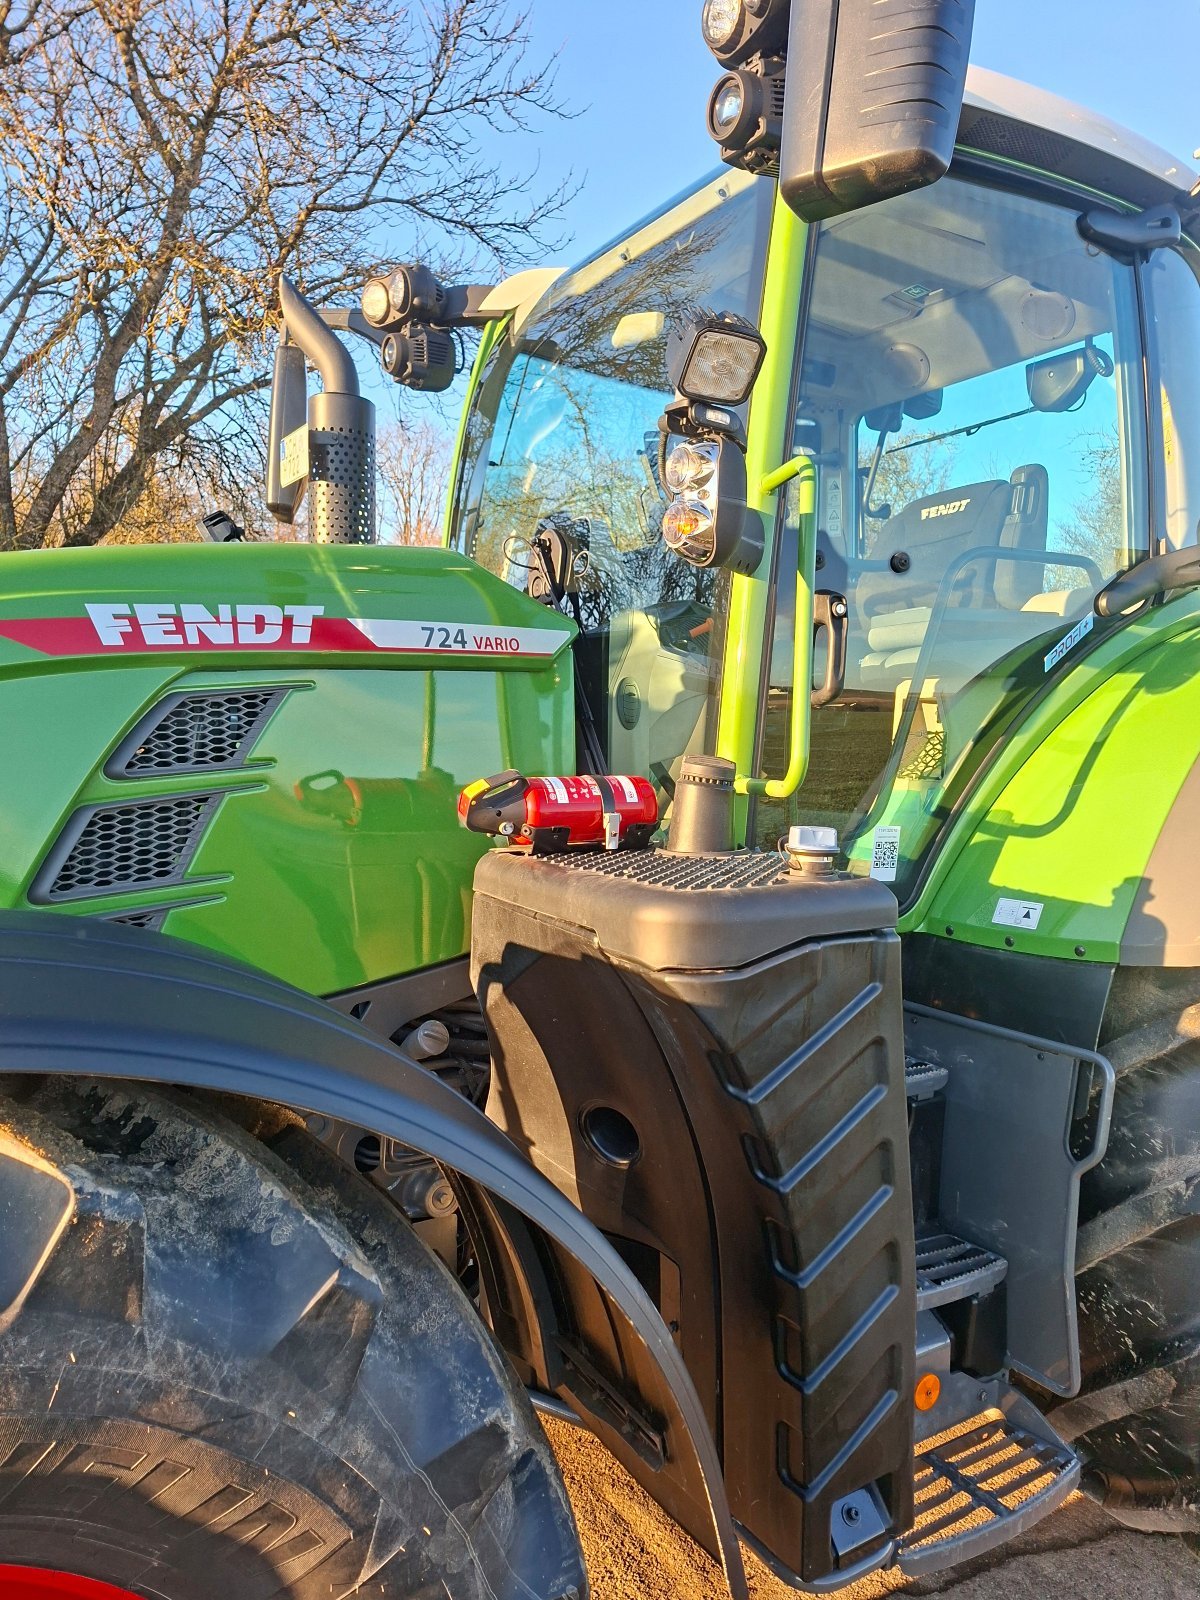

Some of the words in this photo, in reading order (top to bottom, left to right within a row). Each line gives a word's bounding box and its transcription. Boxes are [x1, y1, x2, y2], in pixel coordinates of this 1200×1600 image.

[920, 498, 971, 521] FENDT
[84, 603, 325, 646] FENDT
[420, 626, 468, 649] 724
[473, 635, 521, 652] VARIO
